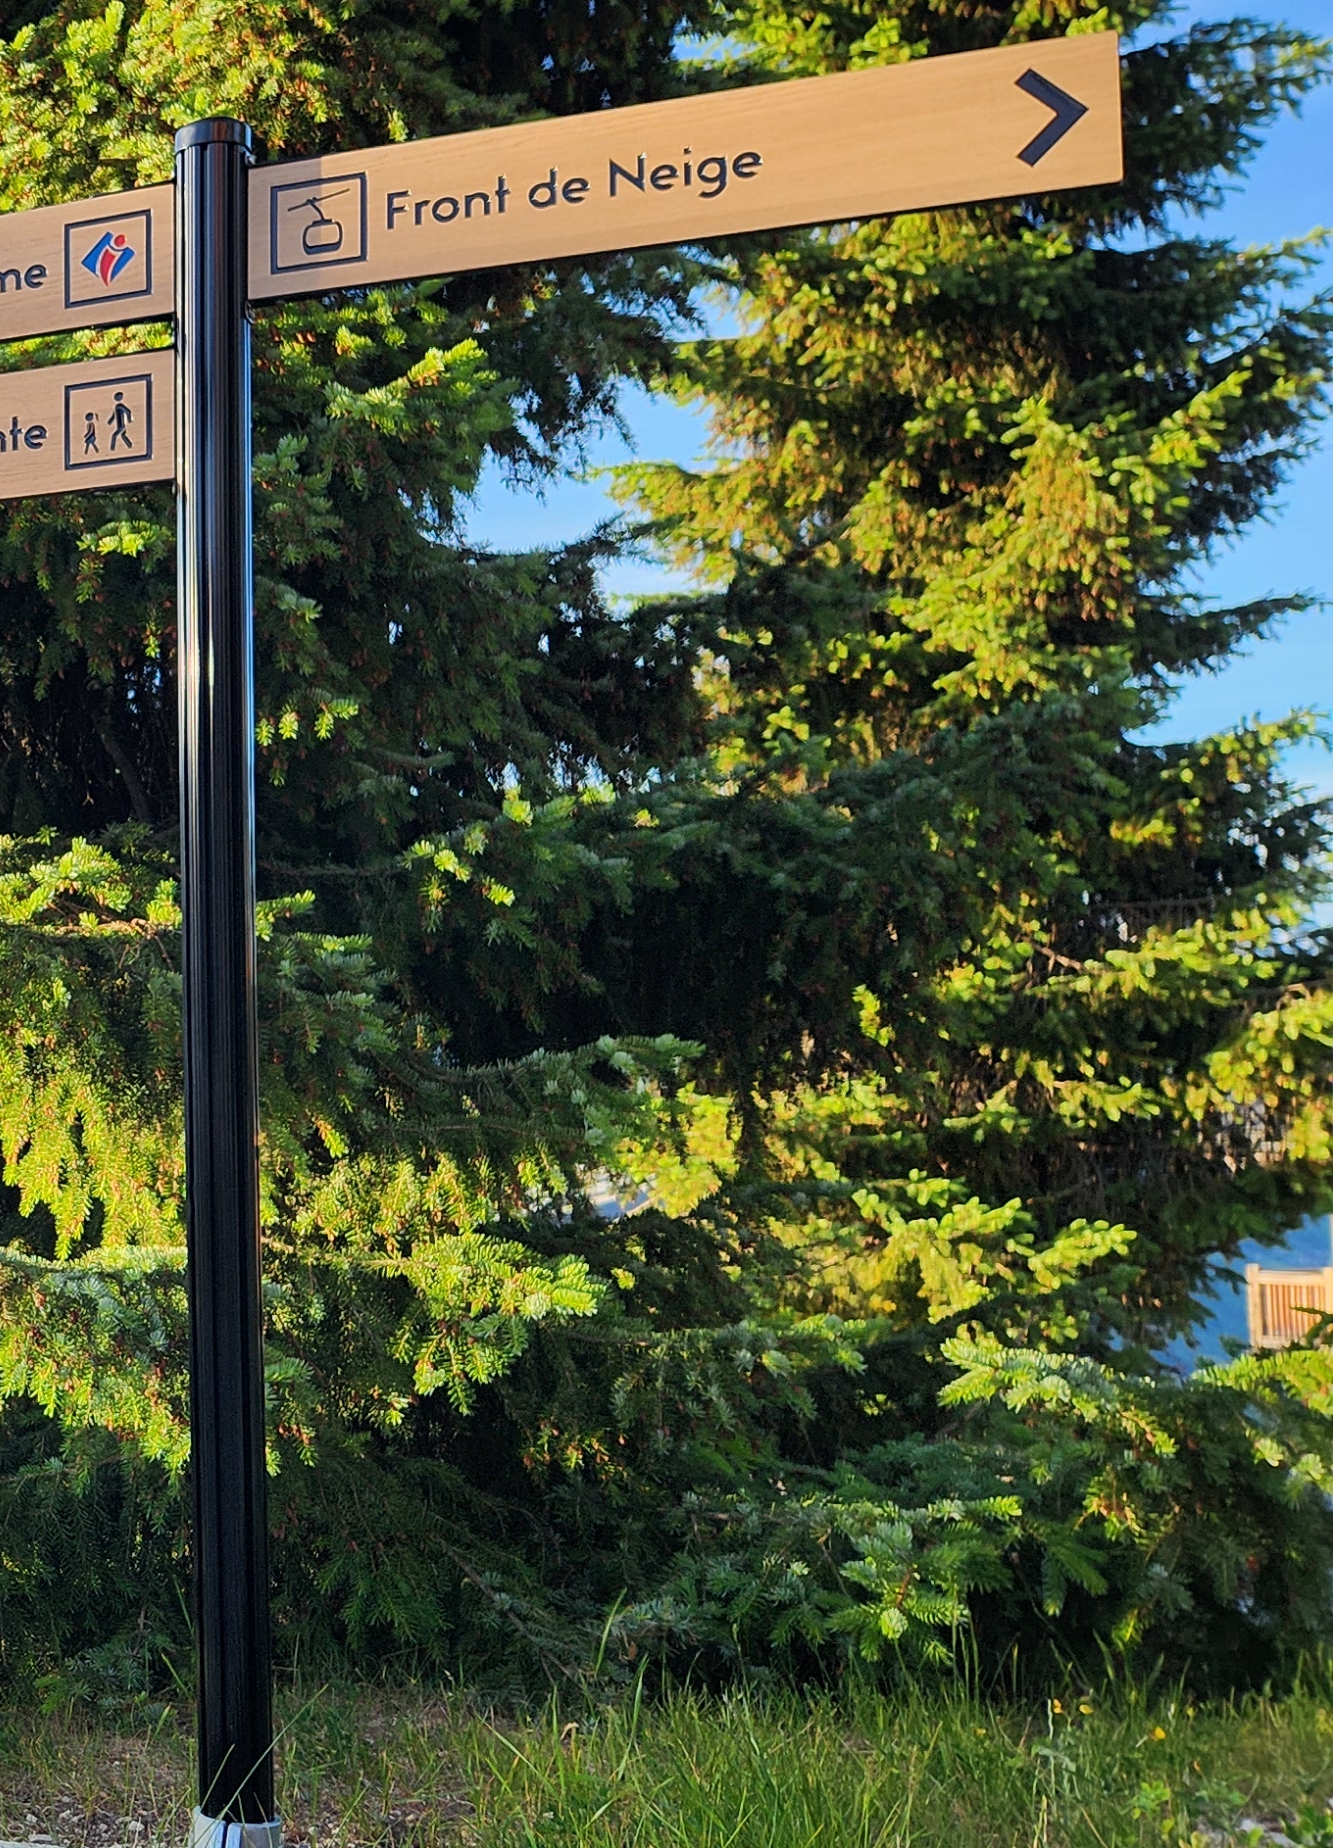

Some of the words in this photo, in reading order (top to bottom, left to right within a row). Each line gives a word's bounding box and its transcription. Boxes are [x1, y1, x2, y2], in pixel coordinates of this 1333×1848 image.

[386, 174, 511, 230] Front
[528, 167, 591, 209] de
[608, 147, 763, 199] Neige
